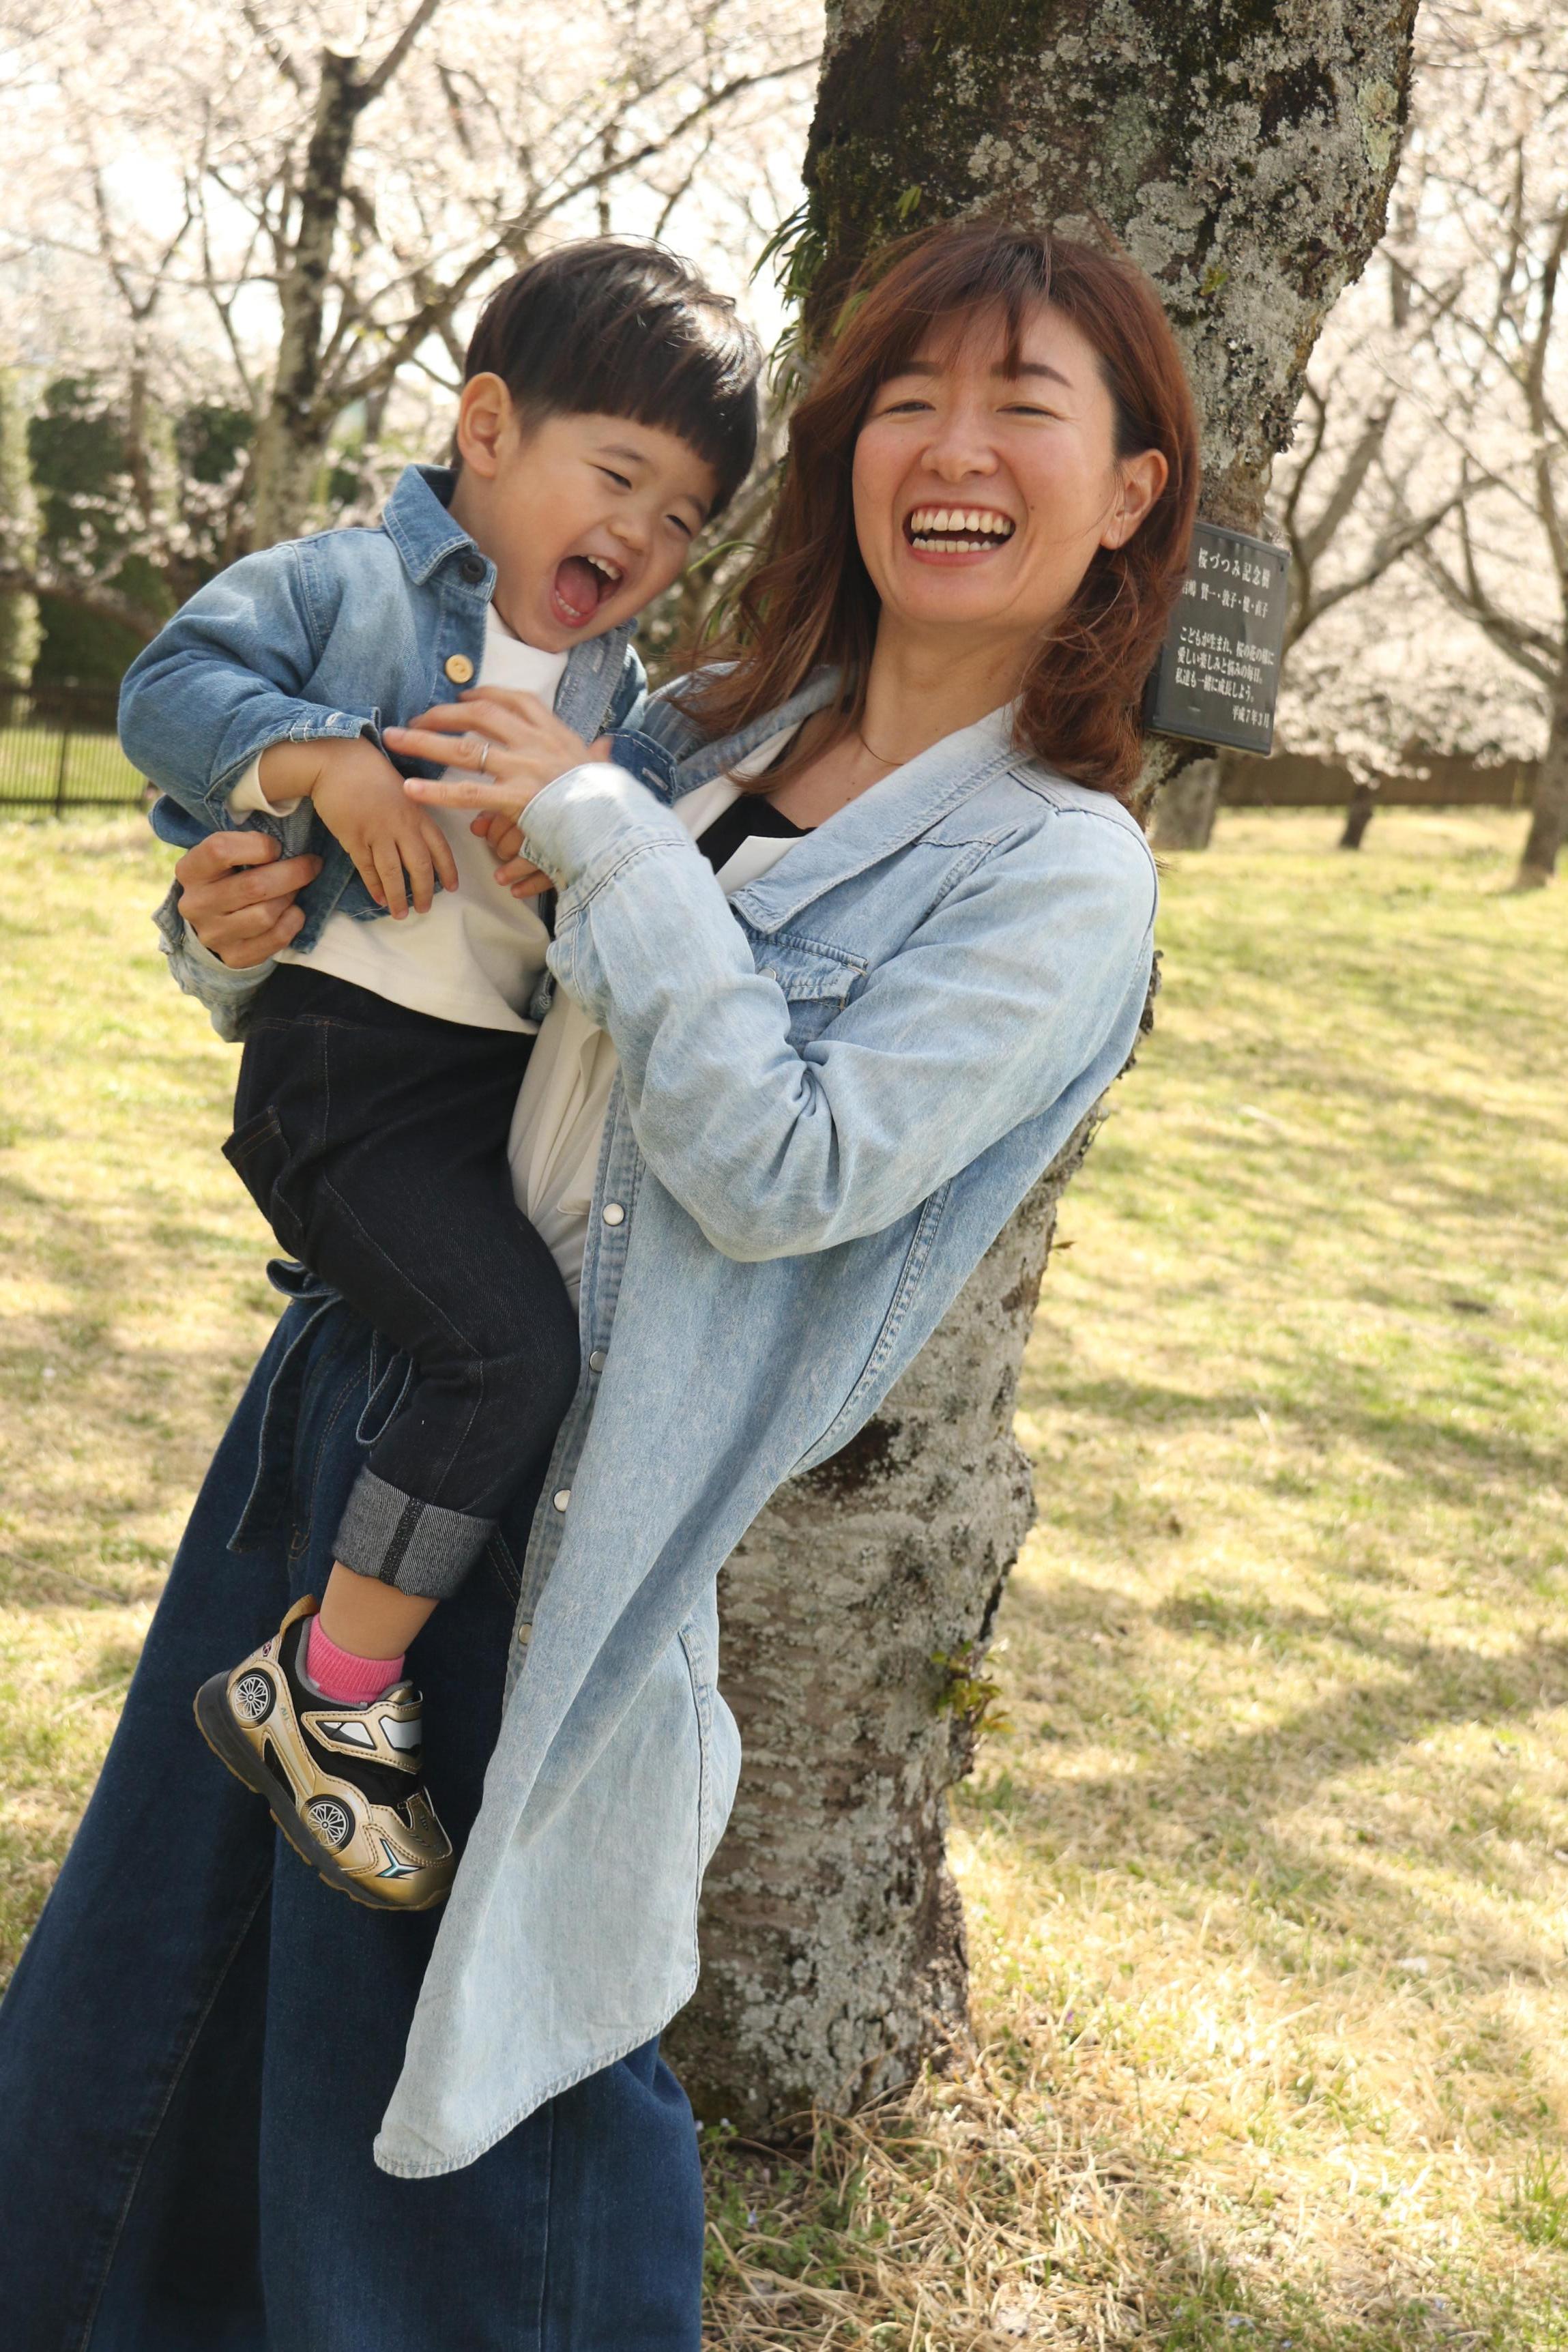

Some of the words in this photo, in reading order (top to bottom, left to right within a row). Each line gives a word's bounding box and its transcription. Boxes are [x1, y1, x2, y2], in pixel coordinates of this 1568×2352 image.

[1198, 547, 1271, 589] 桜づつみ記念樹
